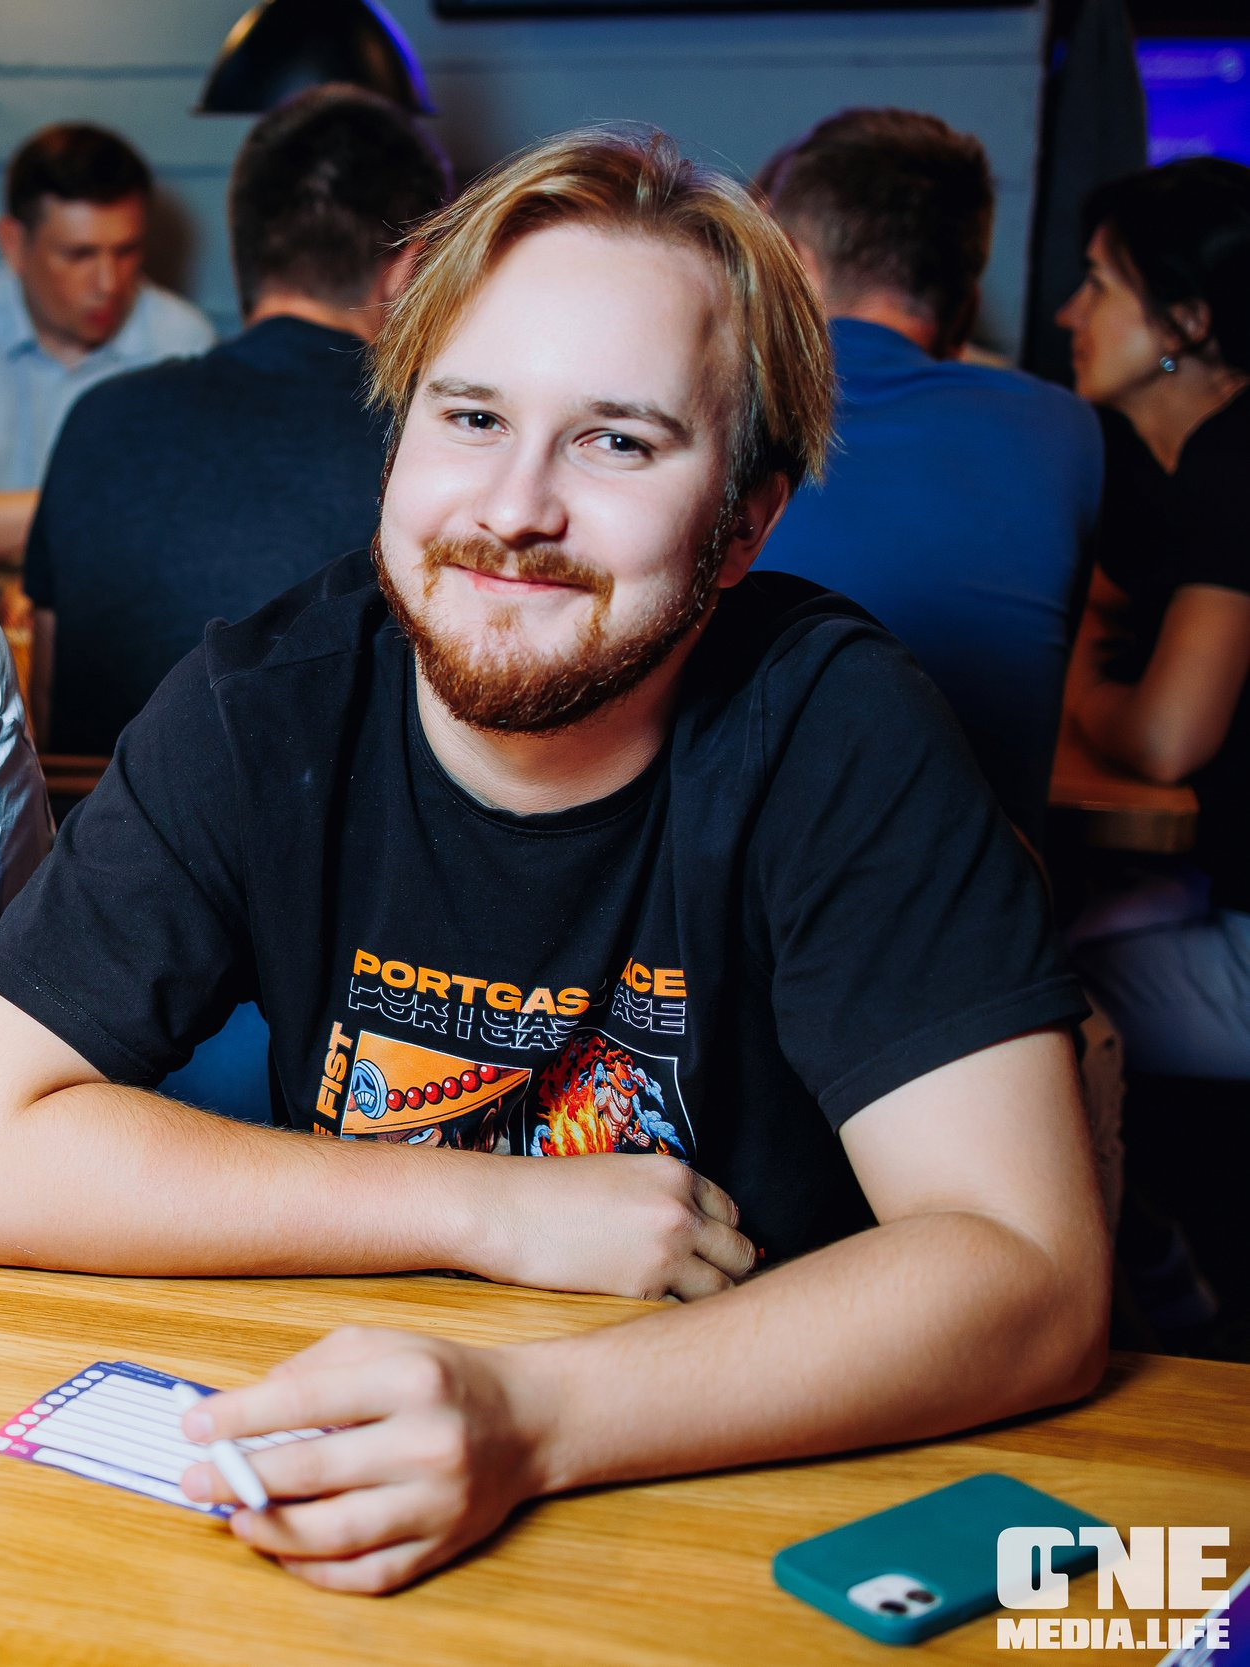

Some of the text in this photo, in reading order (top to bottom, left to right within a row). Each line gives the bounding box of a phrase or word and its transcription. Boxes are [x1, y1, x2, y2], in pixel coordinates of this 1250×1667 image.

[353, 949, 687, 1017] PORTGAS ACE
[316, 1021, 354, 1120] FIST
